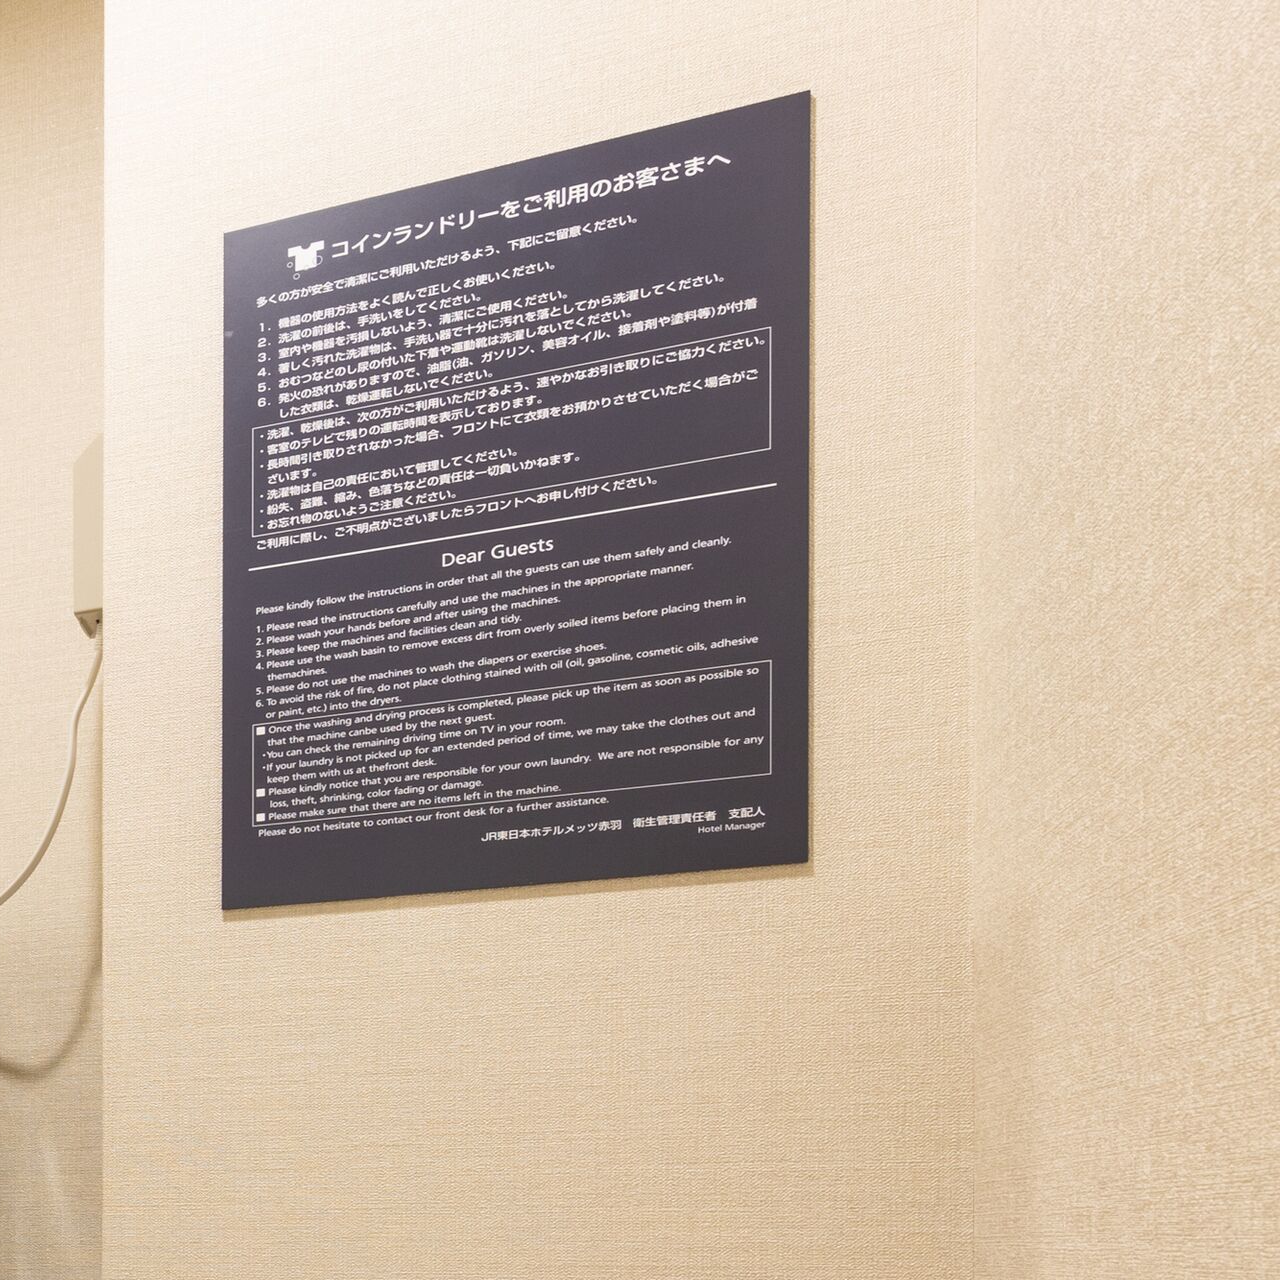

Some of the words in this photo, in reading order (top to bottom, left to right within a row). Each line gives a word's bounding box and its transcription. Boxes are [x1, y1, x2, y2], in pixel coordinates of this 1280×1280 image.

[259, 321, 271, 332] 1.
[256, 336, 271, 348] 2.
[256, 351, 271, 363] 3.
[256, 366, 271, 377] 4.
[257, 381, 271, 393] 5.
[256, 396, 271, 407] 6.
[441, 549, 486, 568] Dear
[490, 538, 554, 559] Guests
[255, 604, 284, 615] Please
[285, 598, 314, 611] kindly
[315, 595, 346, 606] follow
[347, 591, 365, 601] the
[366, 583, 423, 598] instructions
[424, 580, 435, 589] in
[436, 576, 465, 588] order
[466, 572, 488, 583] that
[490, 569, 502, 580] all
[504, 567, 523, 578] the
[524, 562, 559, 577] guests
[560, 559, 580, 569] can
[581, 556, 601, 566] use
[602, 551, 631, 563] them
[633, 544, 665, 558] safely
[666, 540, 689, 553] and
[690, 535, 732, 549] cleanly.
[254, 636, 264, 646] 2.
[265, 634, 295, 644] Please
[296, 628, 321, 640] wash
[322, 626, 345, 638] your
[346, 621, 376, 633] hands
[377, 617, 411, 628] before
[412, 612, 432, 624] and
[433, 609, 459, 620] after
[460, 605, 488, 616] using
[490, 602, 508, 612] the
[510, 595, 561, 609] machines.
[697, 823, 722, 833] Hotel
[724, 821, 766, 831] Manager
